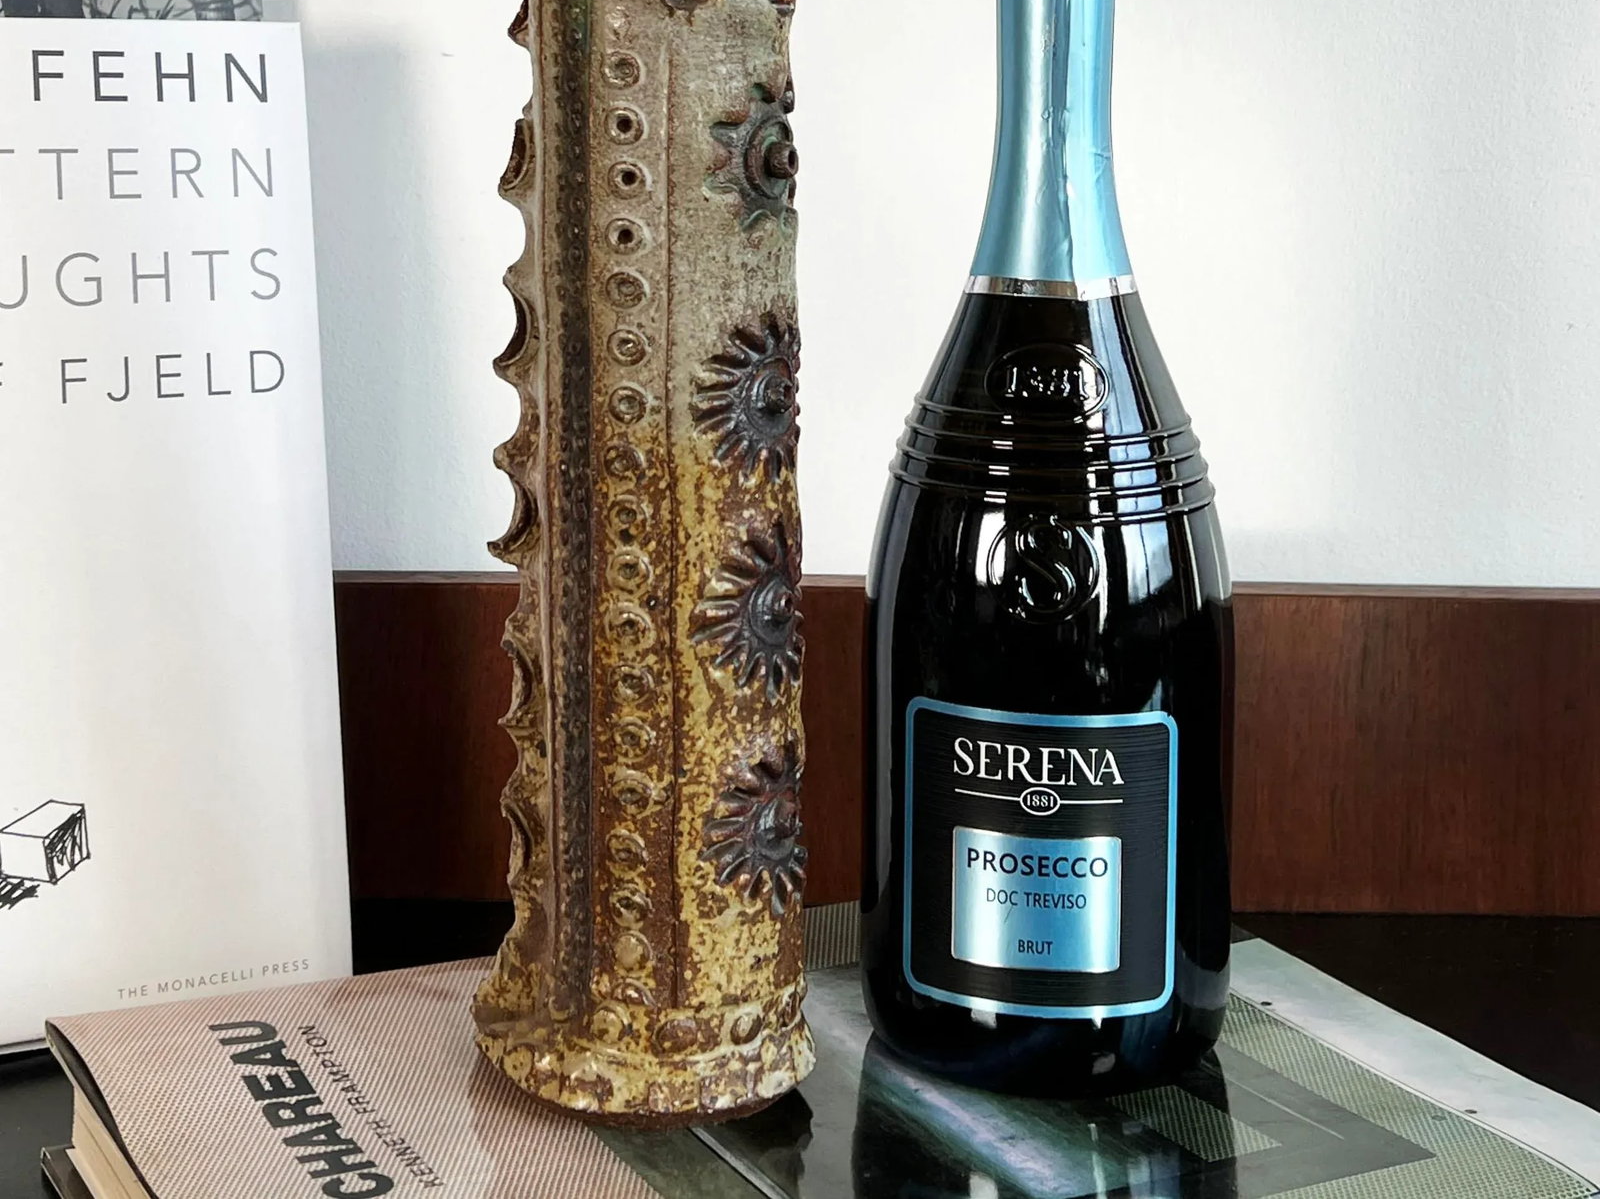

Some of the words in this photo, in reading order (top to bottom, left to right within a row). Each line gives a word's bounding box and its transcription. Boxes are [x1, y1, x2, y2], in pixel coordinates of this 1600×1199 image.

[31, 49, 269, 103] FEHN
[60, 350, 285, 404] FJELD
[953, 737, 1125, 786] SERENA
[1026, 794, 1054, 808] 1881
[966, 847, 1108, 878] PROSECCO
[986, 888, 1019, 906] DOC
[1024, 892, 1087, 909] TREVISO
[1017, 939, 1053, 955] BRUT
[117, 984, 149, 1000] THE
[157, 968, 254, 993] MONACELLI
[261, 958, 310, 976] PRESS
[297, 1023, 376, 1115] FRAMPTON
[208, 1020, 395, 1199] CHAREAU
[366, 1117, 444, 1189] KENNETH
